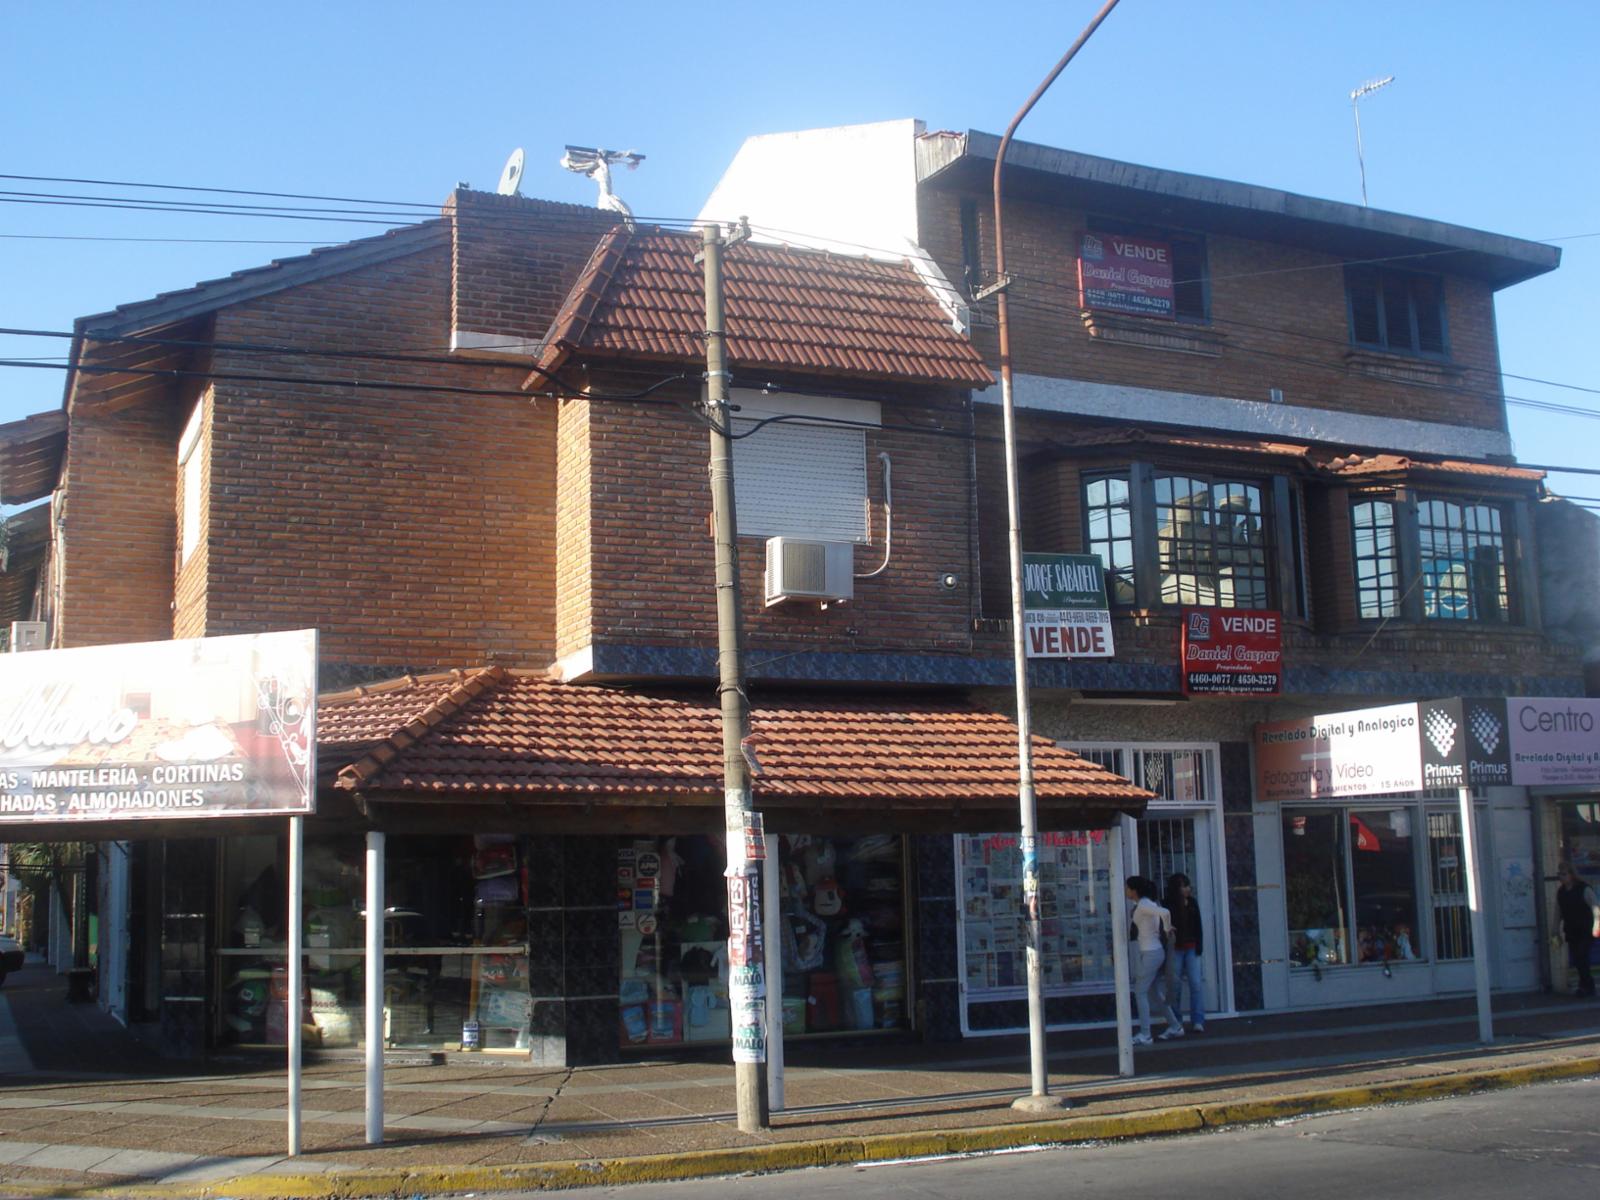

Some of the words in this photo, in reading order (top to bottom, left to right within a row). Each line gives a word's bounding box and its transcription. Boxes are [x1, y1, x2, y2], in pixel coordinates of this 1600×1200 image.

[1113, 242, 1167, 262] VENDE
[1083, 262, 1126, 280] Daniel
[1024, 562, 1054, 599] JORGE
[1055, 560, 1101, 593] SABADELL
[1221, 617, 1276, 633] VENDE
[1029, 626, 1106, 653] VENDE
[1187, 644, 1232, 660] Daniel
[1234, 645, 1280, 664] Gaspar
[1189, 673, 1231, 684] 4460-0077
[1237, 674, 1277, 685] 4650-3279
[1519, 705, 1593, 733] Centro
[1262, 727, 1306, 743] Revelado
[1309, 722, 1345, 740] Digital
[1348, 725, 1354, 738] y
[1358, 716, 1414, 733] Analogico
[1515, 752, 1553, 763] Revelado
[1556, 752, 1584, 764] Digital
[32, 763, 138, 788] MANTELERÍA
[152, 762, 244, 785] CORTINAS
[1336, 763, 1373, 779] Video
[1425, 763, 1463, 778] Primus
[1470, 760, 1508, 774] Primus
[1381, 780, 1391, 789] 15
[1425, 776, 1463, 787] DIGITAL
[1, 793, 56, 812] HADAS
[68, 789, 204, 810] ALMOHADONES
[730, 878, 745, 954] JUEVES
[734, 974, 762, 986] MALO
[735, 1038, 764, 1050] MALO
